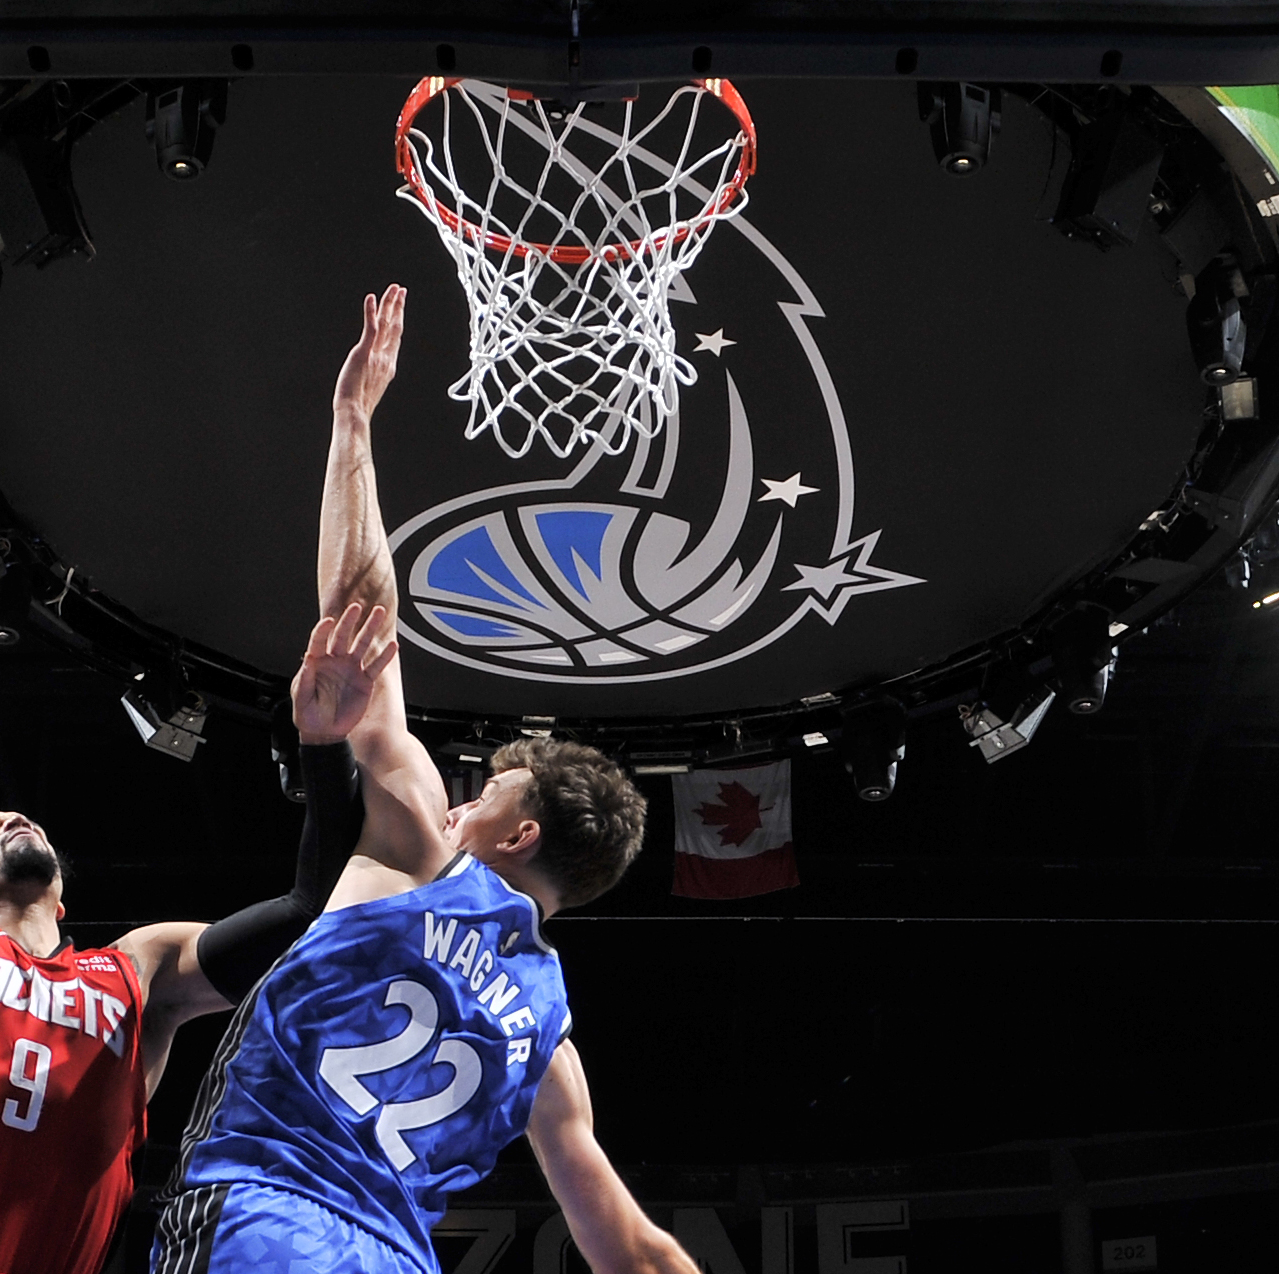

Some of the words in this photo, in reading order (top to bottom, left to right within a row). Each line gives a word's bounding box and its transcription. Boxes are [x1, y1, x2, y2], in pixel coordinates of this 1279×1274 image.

[423, 910, 537, 1067] WAGNER
[1, 1037, 52, 1133] 9
[318, 978, 483, 1173] 22
[1113, 1245, 1146, 1261] 202
